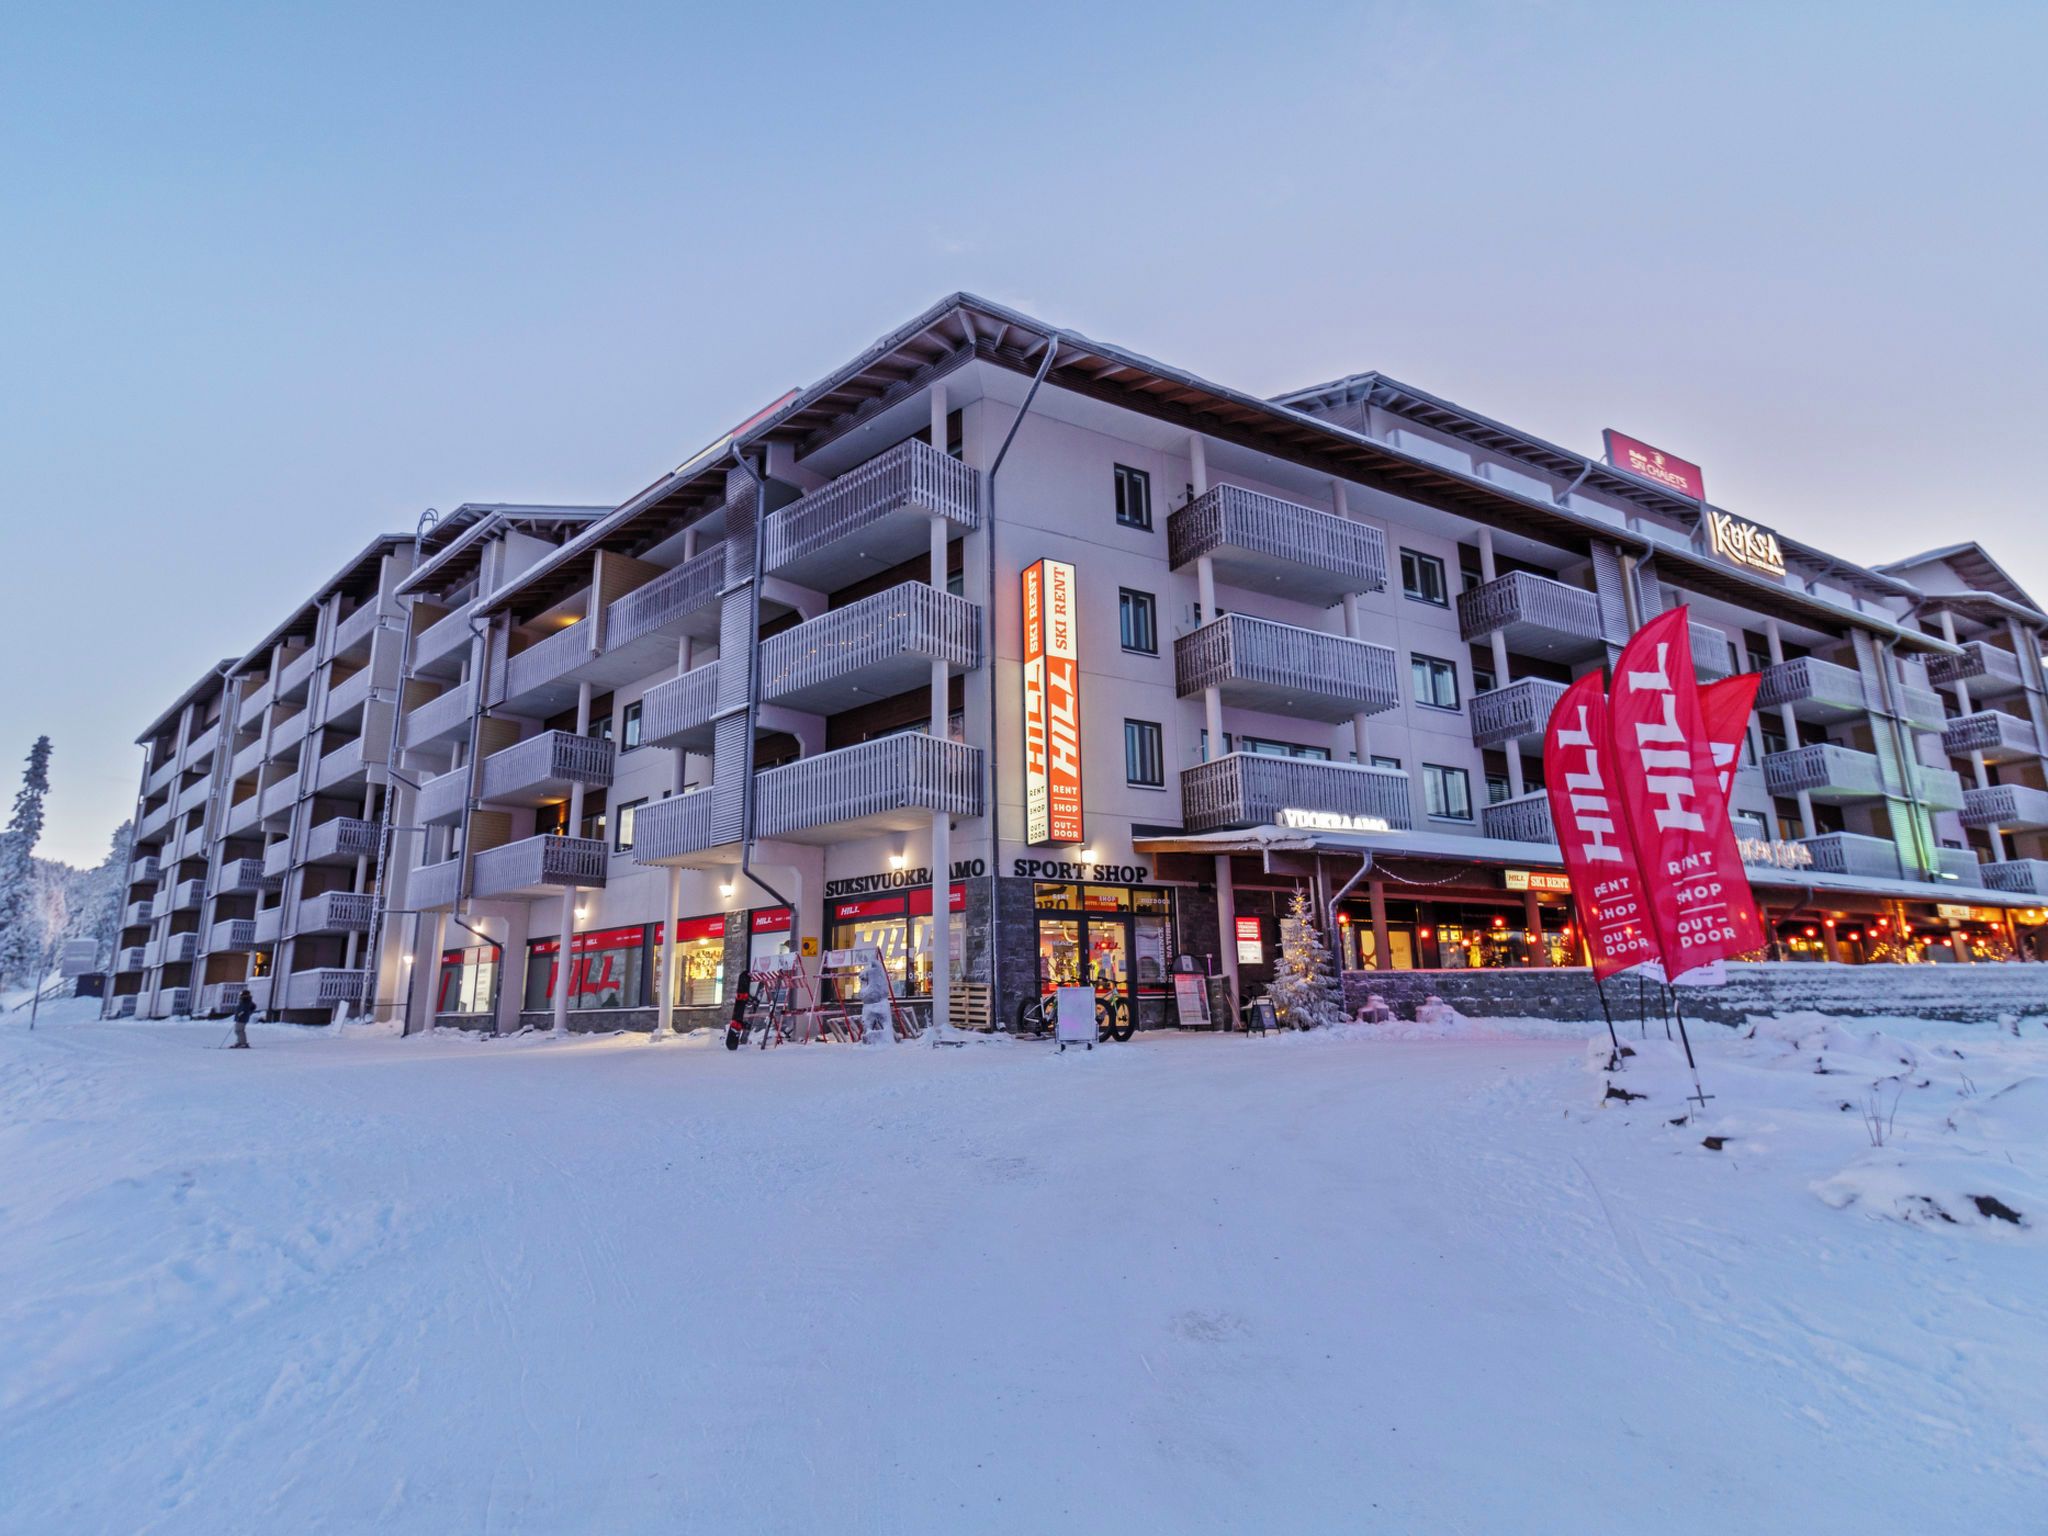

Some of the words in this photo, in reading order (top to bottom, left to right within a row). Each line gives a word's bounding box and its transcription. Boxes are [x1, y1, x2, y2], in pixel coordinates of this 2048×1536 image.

[1027, 570, 1038, 621] RENT
[1053, 567, 1066, 615] RENT
[1029, 621, 1038, 654] SKI
[1055, 621, 1067, 650] SKI
[1027, 664, 1044, 775] HILL
[1050, 663, 1077, 778] HILL
[1628, 643, 1705, 833] HILL
[1029, 785, 1045, 797] RENT
[1053, 784, 1078, 795] RENT
[1557, 705, 1624, 864] HILL
[1030, 804, 1045, 815] SHOP
[1053, 803, 1078, 813] SHOP
[1054, 821, 1077, 829] OUT-
[1054, 829, 1079, 838] DOOR
[1014, 858, 1087, 880] SPORT
[1093, 864, 1148, 883] SHOP
[1667, 851, 1712, 876] RNT
[826, 858, 985, 897] SUKSIVUOKRMO
[1530, 876, 1546, 888] SKI
[1546, 877, 1569, 889] RENT
[840, 906, 860, 915] HILL
[755, 917, 773, 926] HILL
[1677, 916, 1728, 934] OUT-
[1603, 928, 1642, 944] OUT-
[1680, 927, 1737, 949] DOOR
[1605, 938, 1649, 956] DOOR
